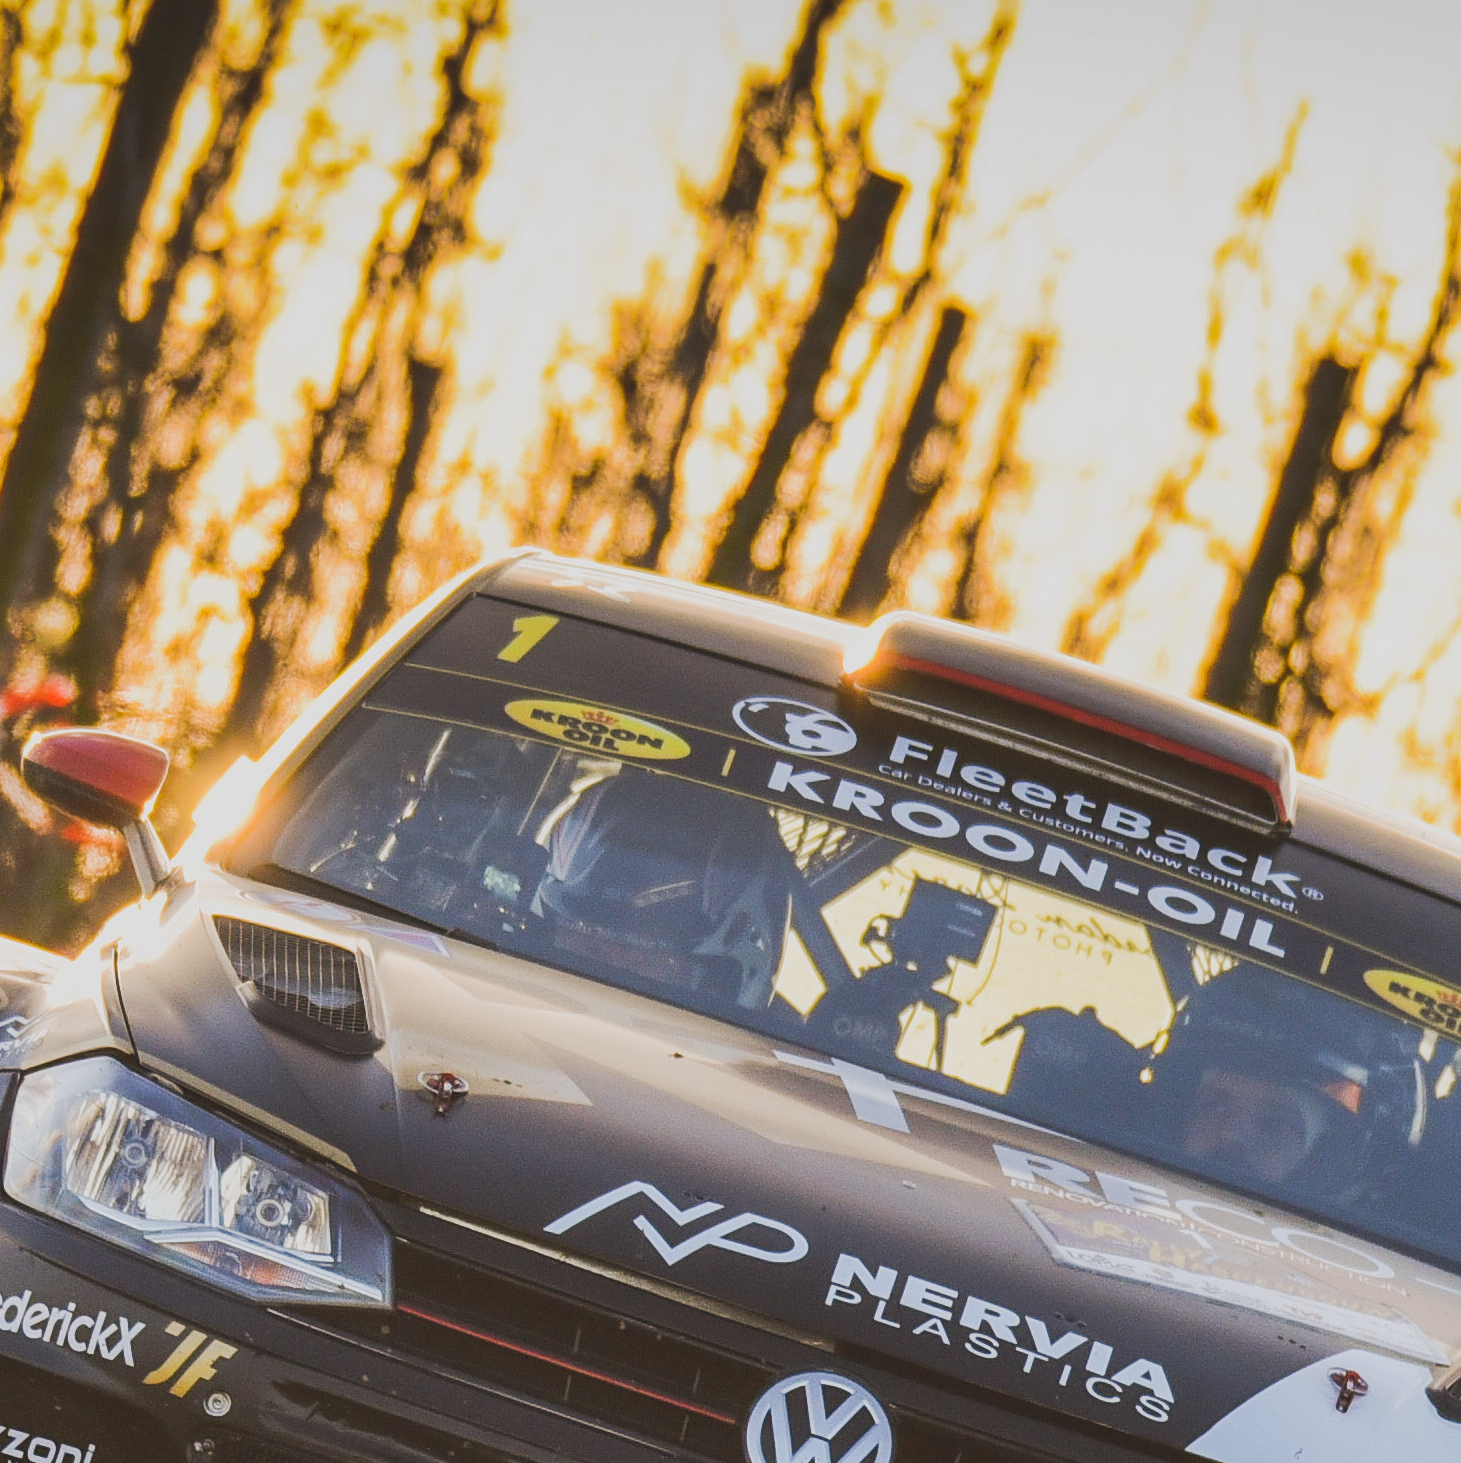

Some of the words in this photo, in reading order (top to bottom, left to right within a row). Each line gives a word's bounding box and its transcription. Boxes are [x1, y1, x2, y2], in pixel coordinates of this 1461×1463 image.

[496, 614, 560, 664] 1
[530, 708, 664, 750] KROON
[562, 728, 619, 752] OIL
[766, 760, 1287, 960] KROON-OIL
[917, 774, 992, 806] Dealers
[997, 800, 1013, 813] &
[1136, 845, 1182, 870] Now
[992, 1143, 1396, 1279] RECO
[824, 1284, 1171, 1423] PLASTICS
[830, 1252, 1175, 1404] NERVIA
